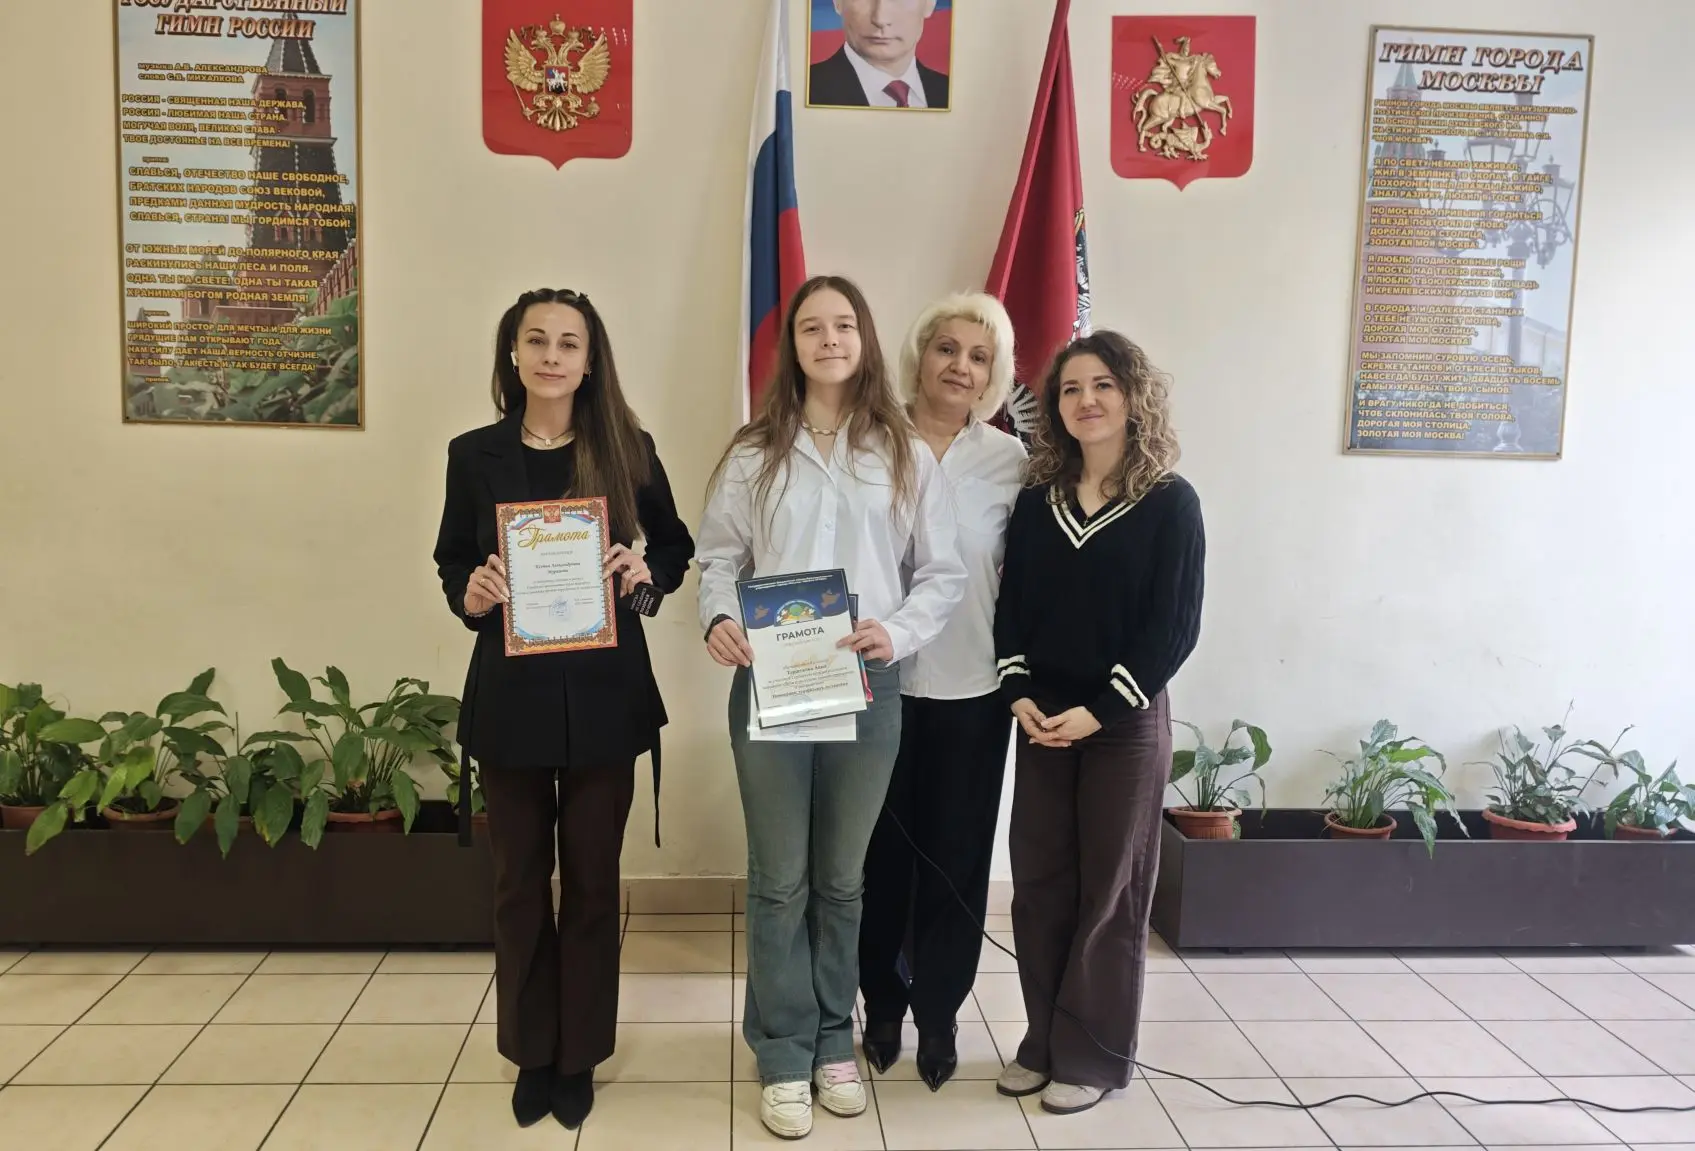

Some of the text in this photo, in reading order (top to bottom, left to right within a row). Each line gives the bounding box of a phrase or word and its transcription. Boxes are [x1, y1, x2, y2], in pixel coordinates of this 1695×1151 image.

[120, 0, 346, 14] СТВЕННЫЙ
[155, 14, 315, 40] ГИМН РОССИИ
[1379, 42, 1583, 74] ГИМН ГОРОДА
[194, 64, 268, 74] АЛЕКСАНДРОВА
[187, 74, 244, 83] МИХАЛКОВА
[1418, 70, 1544, 94] МОСКВЫ
[122, 94, 306, 109] РОССИЯ СВЯЩЕННАЯ НАША ДЕРЖАВА,
[122, 108, 160, 117] РОССИЯ
[167, 109, 216, 118] ЛЮБИМАЯ
[218, 111, 246, 120] НАША
[123, 121, 275, 134] МОГУЧАЯ ВОЛЯ, ВЕЛИКАЯ СЛАВА
[123, 134, 148, 143] ТВОЕ
[149, 135, 206, 145] ДОСТОЯНЬЕ
[208, 137, 221, 145] НА
[244, 139, 290, 147] ВРЕМЕНА!
[129, 167, 349, 185] СЛАВЬСЯ, ОТЕЧЕСТВО НАШЕ СВОБОДНОЕ,
[129, 181, 326, 198] БРАТСКИХ НАРОДОВ СОЮЗ ВЕКОВОЙ,
[129, 196, 353, 213] ПРЕДКАМИ ДАННАЯ МУДРОСТЬ НАРОДНАЯ!
[1387, 207, 1435, 216] МОСКВОЮ
[130, 211, 350, 228] СЛАВЬСЯ, СТРАНА! МЫ ГОРДИМСЯ ТОБОЙ!
[1370, 228, 1413, 236] ДОРОГАЯ
[126, 244, 339, 259] ОТ ЮЖНЫХ МОРЕЙ ДО ПОЛЯРНОГО КРАЯ
[1377, 255, 1414, 264] ЛЮБЛЮ
[126, 259, 312, 273] РАСКИНУЛИСЬ НАШИ ЛЕСА И ПОЛЯ.
[1376, 266, 1411, 274] МОСТЫ
[127, 274, 156, 283] ОДНА
[159, 274, 175, 283] ТЫ
[177, 275, 192, 283] НА
[234, 278, 262, 286] ОДНА
[285, 280, 318, 288] ТАКАЯ
[1375, 276, 1412, 284] ЛЮБЛЮ
[127, 288, 308, 302] ХРАНИМАЯ БОГОМ РОДНАЯ ЗЕМЛЯ!
[1375, 286, 1442, 296] КРЕМЛЕВСКИХ
[1374, 304, 1417, 313] ГОРОДАХ
[128, 321, 172, 330] ШИРОКИЙ
[174, 322, 214, 330] ПРОСТОР
[300, 327, 331, 335] ЖИЗНИ
[1363, 325, 1406, 333] ДОРОГАЯ
[128, 333, 176, 342] ГРЯДУЩИЕ
[178, 334, 196, 343] НАМ
[199, 336, 254, 344] ОТКРЫВАЮТ
[1363, 335, 1406, 343] ЗОЛОТАЯ
[128, 345, 318, 359] НАМ СИЛУ ДАЕТ НАША ВЕРНОСТЬ ОТЧИЗНЕ.
[1380, 352, 1432, 360] ЗАПОМНИМ
[280, 363, 316, 371] ВСЕГДА!
[1361, 362, 1403, 370] СКРЕЖЕТ
[1408, 363, 1443, 371] ТАНКОВ
[1360, 372, 1408, 380] НАВСЕГДА
[1396, 383, 1439, 391] ХРАБРЫХ
[1385, 410, 1446, 418] СКЛОНИЛАСЬ
[517, 524, 590, 550] Грамота
[776, 626, 825, 641] ГРАМОТА
